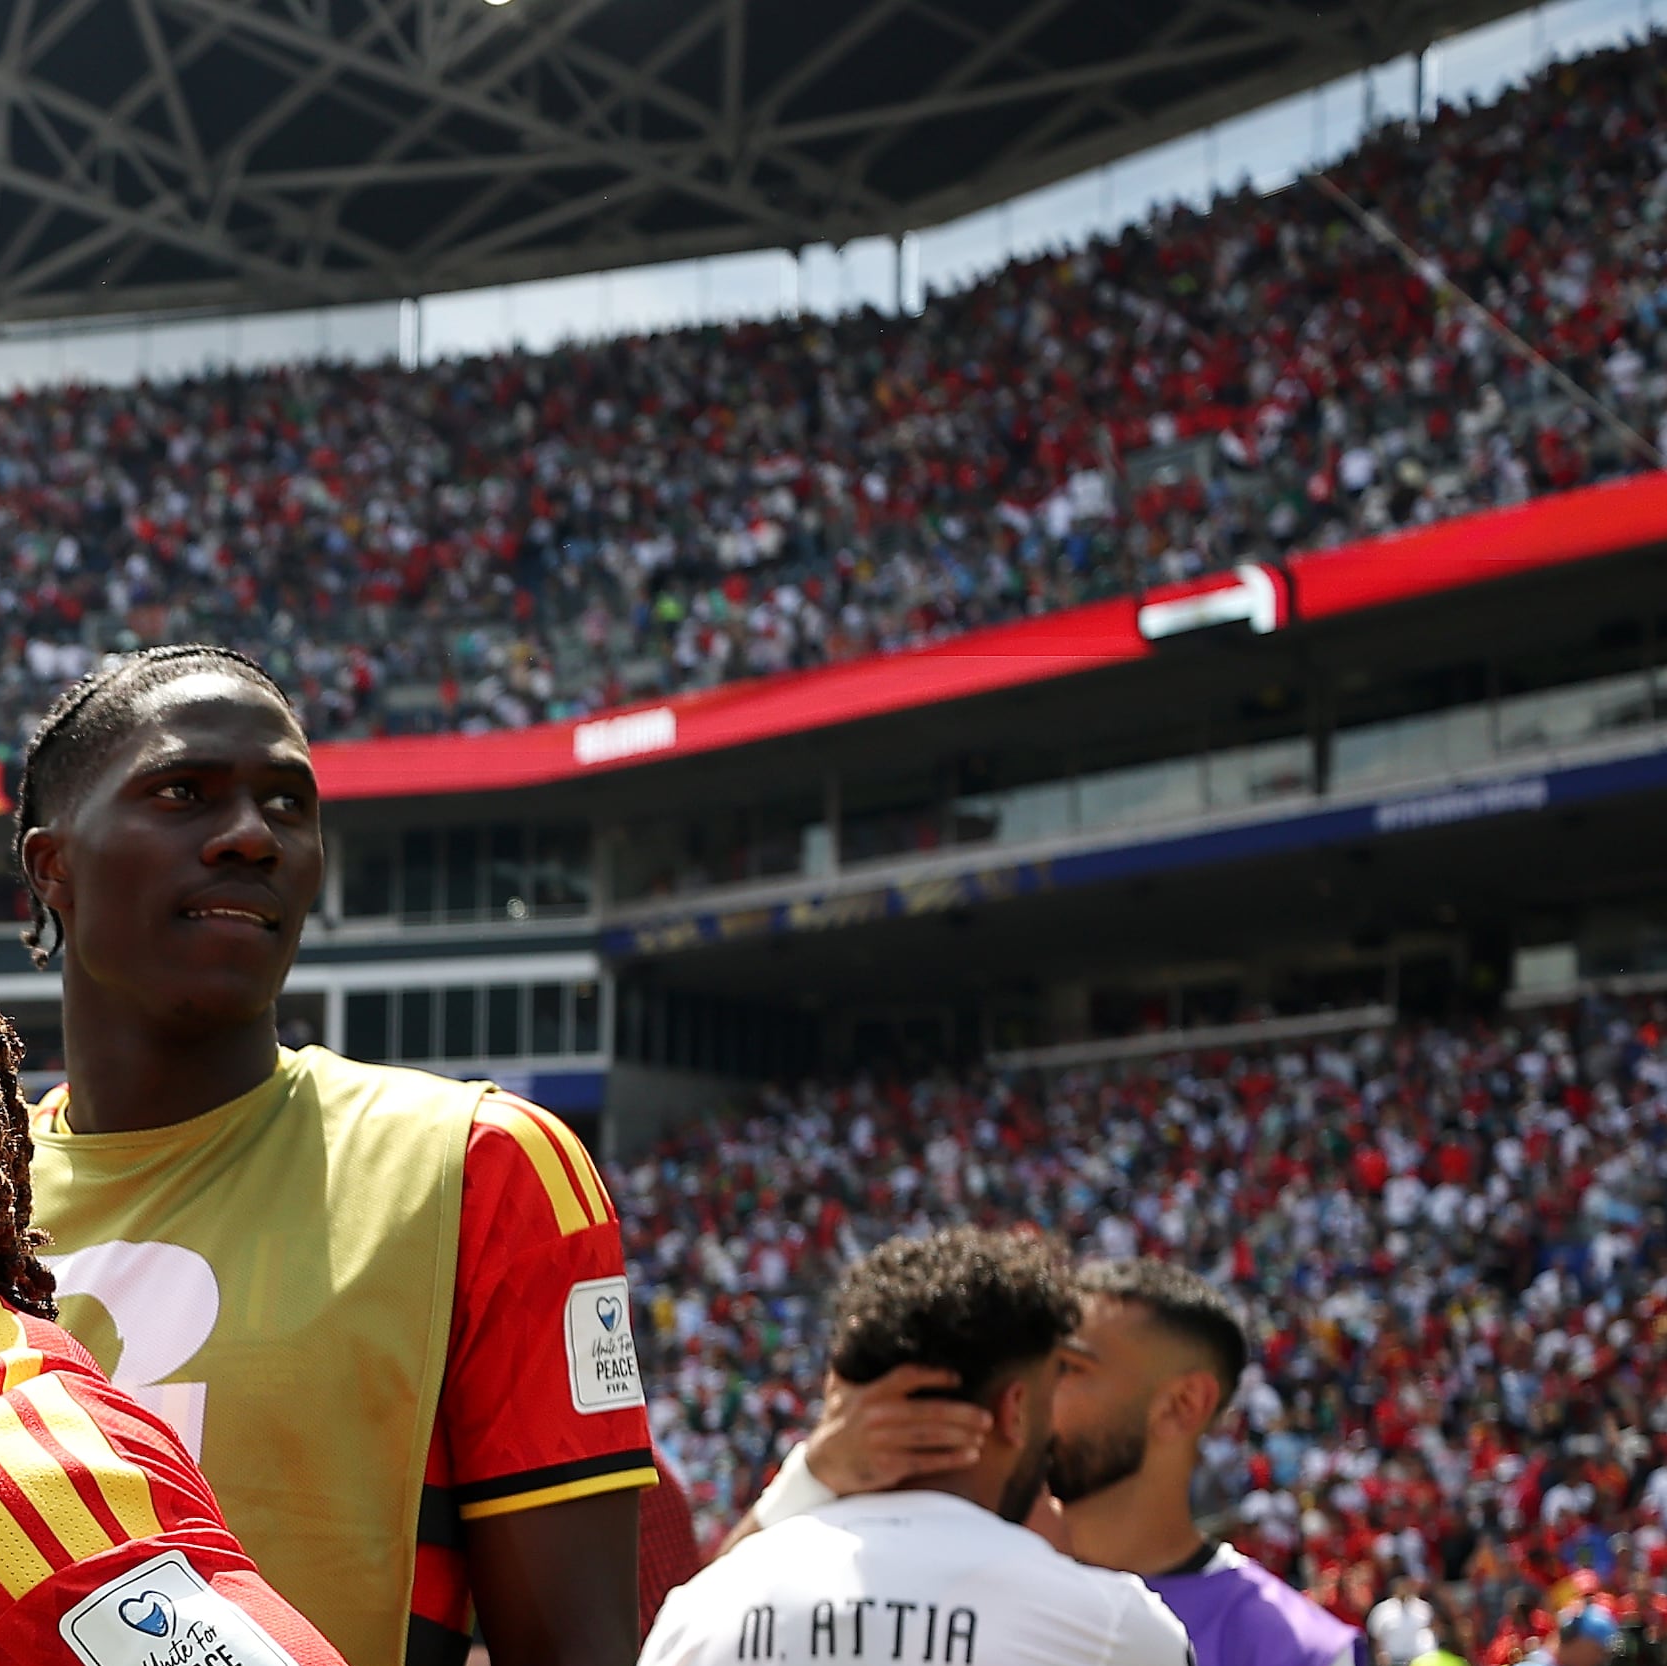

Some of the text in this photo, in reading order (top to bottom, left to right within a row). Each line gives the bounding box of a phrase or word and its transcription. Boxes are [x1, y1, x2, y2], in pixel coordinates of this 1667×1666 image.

[596, 1357, 635, 1381] PEACE
[606, 1381, 629, 1394] FIFA
[186, 1620, 218, 1653] For
[810, 1599, 979, 1665] ATTIA
